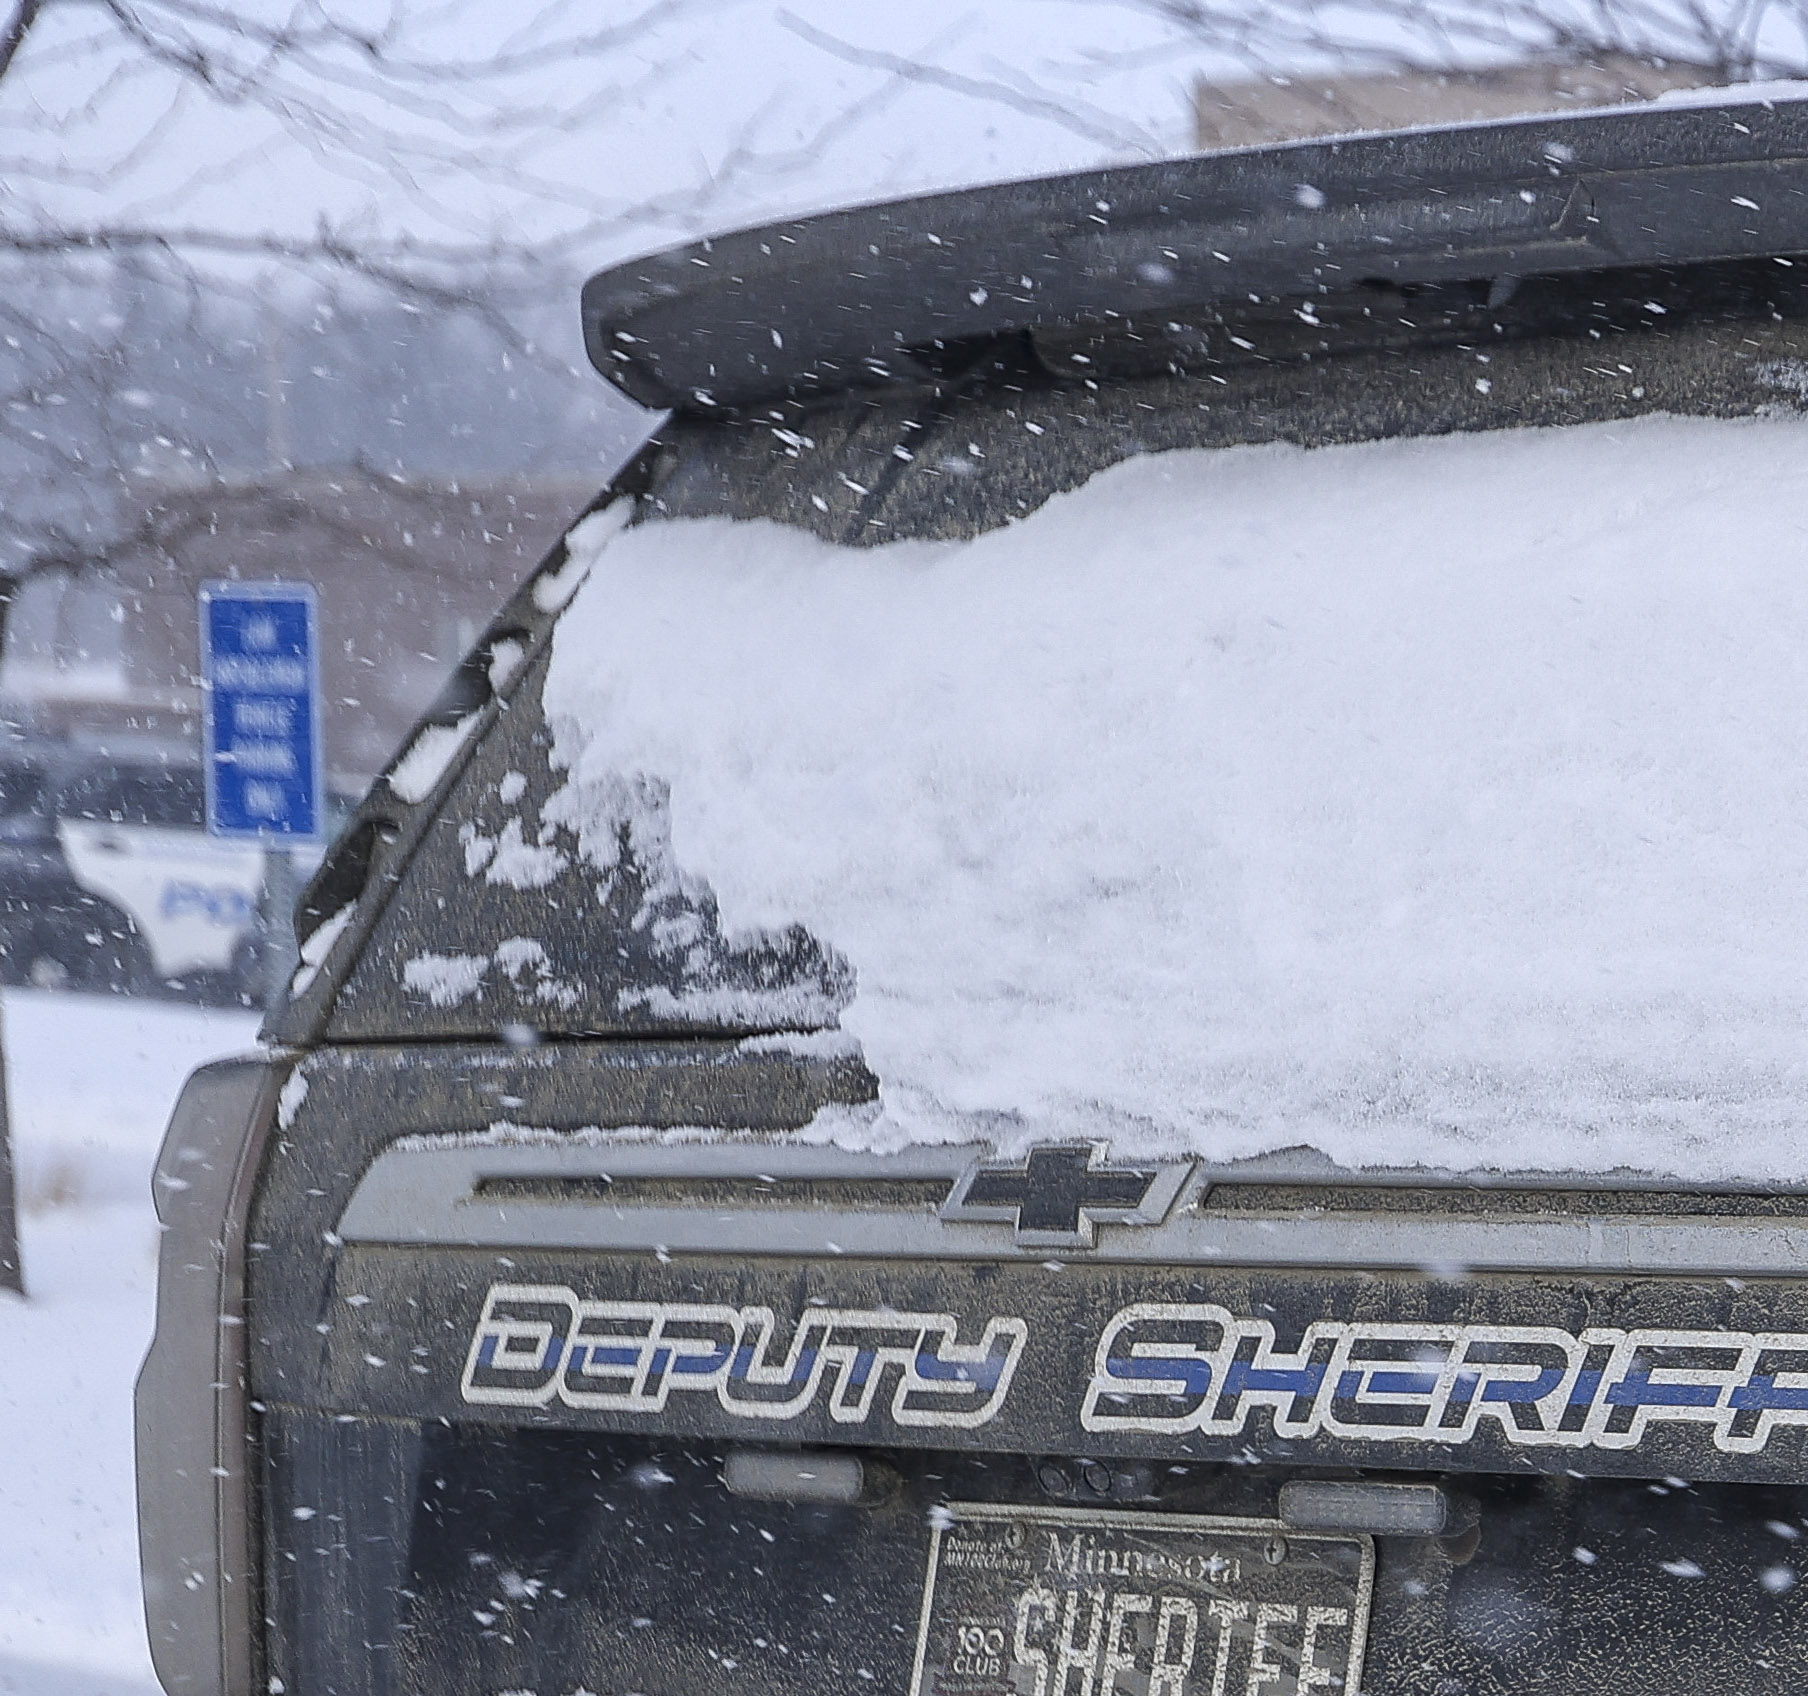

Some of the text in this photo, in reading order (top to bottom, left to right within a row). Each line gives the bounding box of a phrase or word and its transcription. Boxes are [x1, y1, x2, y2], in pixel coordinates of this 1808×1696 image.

[461, 1284, 1027, 1429] DEPUTY
[1044, 1532, 1242, 1583] Minnesota
[958, 1626, 1004, 1655] 100
[953, 1655, 1002, 1676] CLUB
